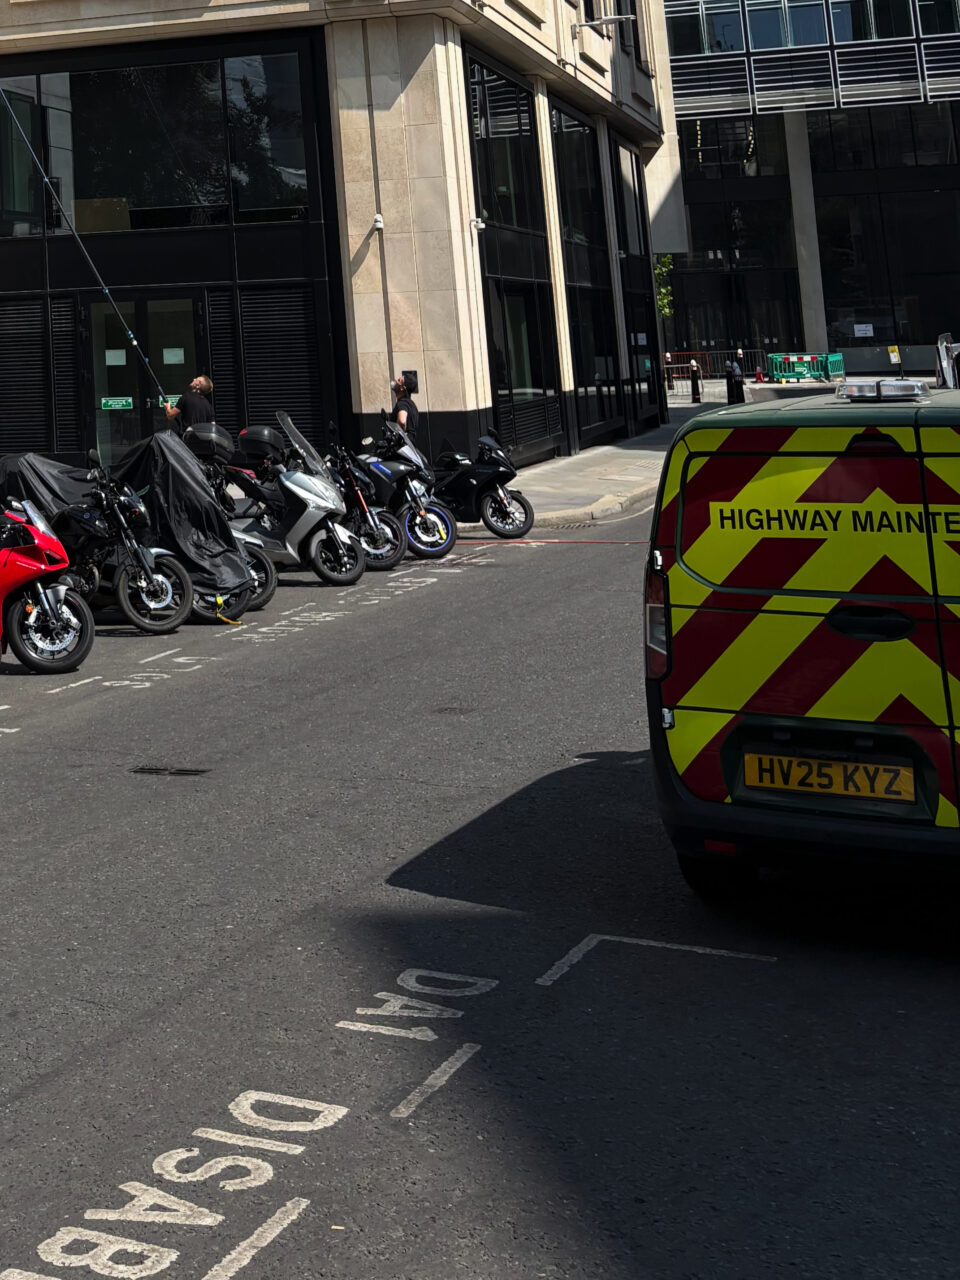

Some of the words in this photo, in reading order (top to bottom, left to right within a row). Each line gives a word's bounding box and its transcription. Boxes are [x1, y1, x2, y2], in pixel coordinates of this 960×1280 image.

[718, 508, 843, 532] HIGHWAY
[851, 510, 960, 535] MAINTE
[756, 756, 834, 790] HV25
[842, 764, 902, 797] KYZ
